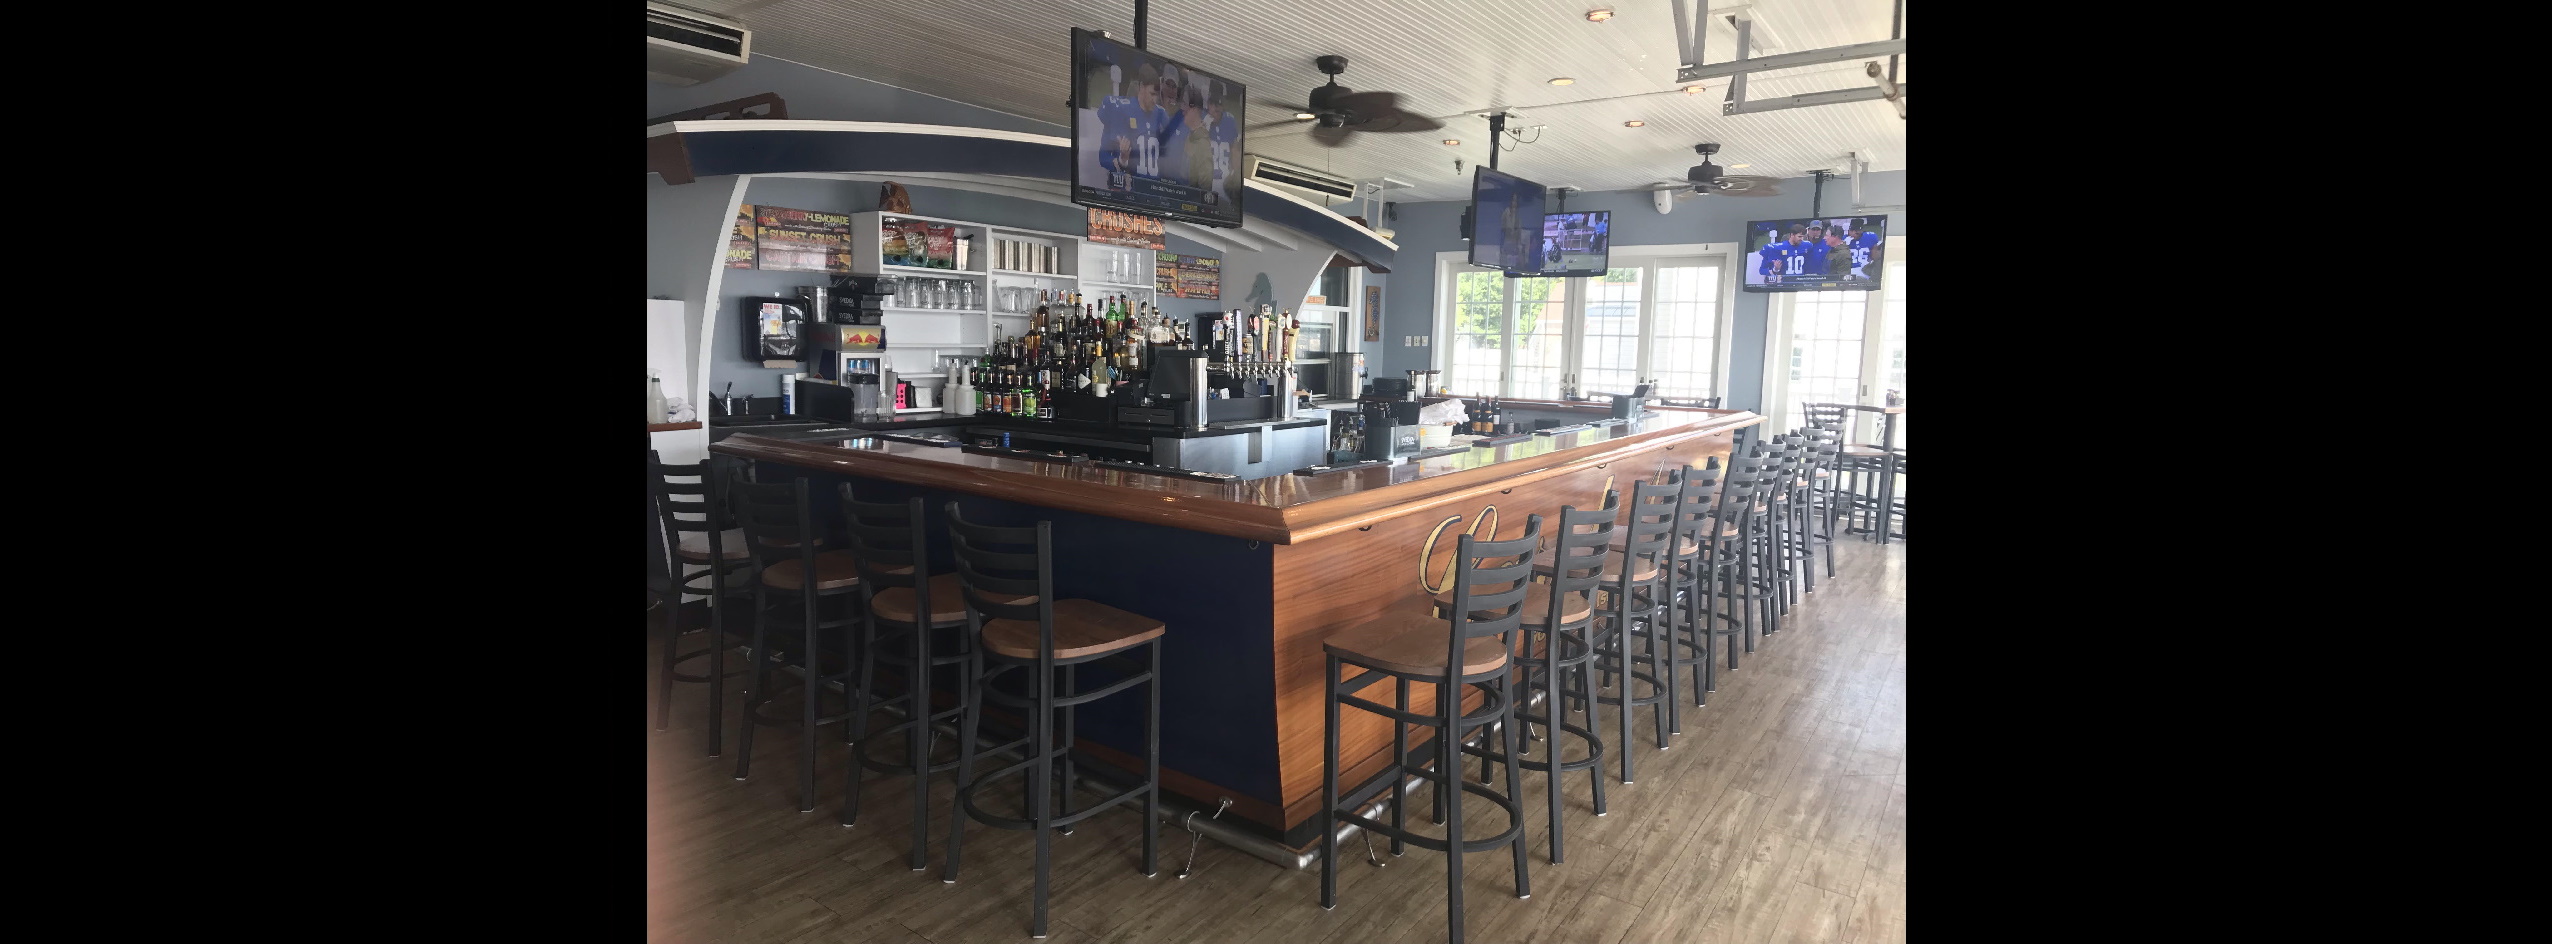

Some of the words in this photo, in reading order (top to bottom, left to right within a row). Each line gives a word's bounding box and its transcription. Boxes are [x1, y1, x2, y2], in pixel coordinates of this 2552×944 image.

[1137, 135, 1160, 177] 10
[1090, 207, 1164, 236] CRUSHES
[769, 229, 806, 243] SUNSET
[809, 233, 841, 246] CRUSH
[1786, 256, 1804, 274] 10
